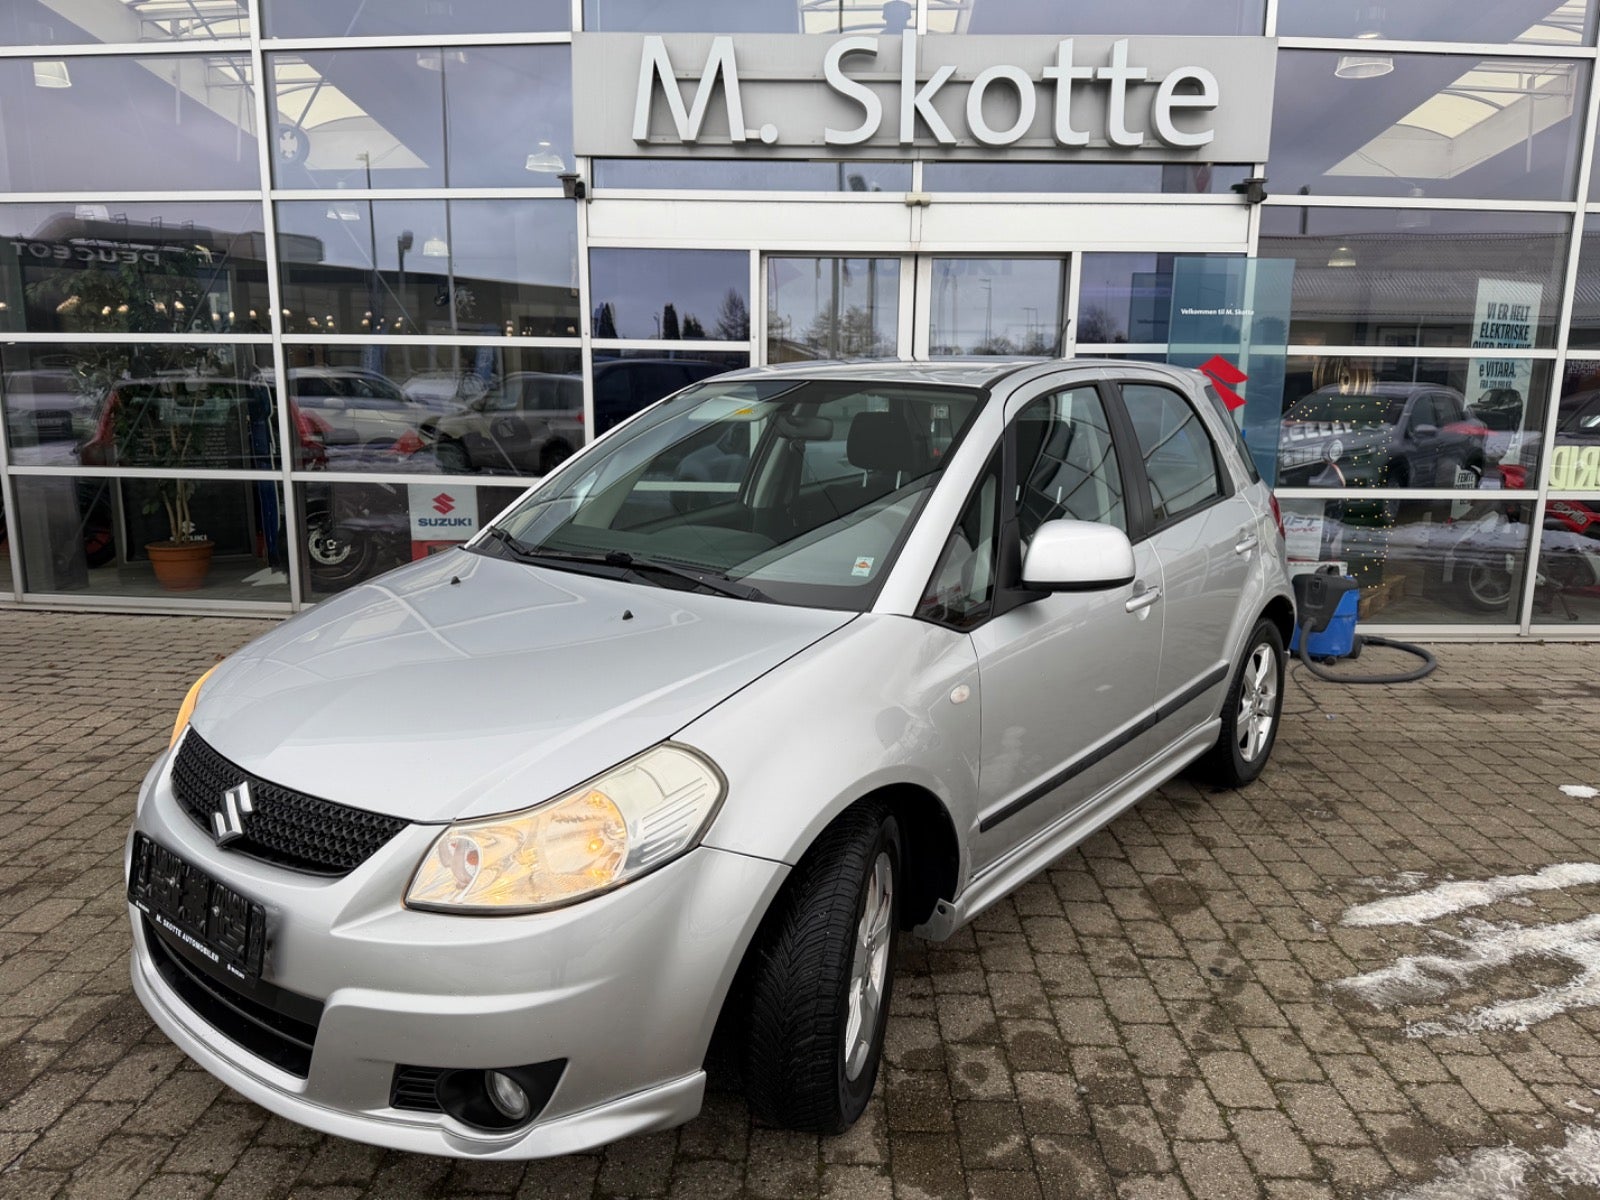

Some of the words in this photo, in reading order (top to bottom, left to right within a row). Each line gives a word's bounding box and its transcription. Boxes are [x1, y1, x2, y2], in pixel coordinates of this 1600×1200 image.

[632, 35, 779, 145] M.
[823, 29, 1220, 149] Skotte
[1181, 308, 1217, 316] Velkommen
[1235, 308, 1255, 317] Skotte
[1487, 302, 1497, 319] VI
[1498, 303, 1508, 320] ER
[1510, 305, 1531, 322] HELT
[1480, 322, 1530, 340] ELEKTRISKE
[418, 517, 472, 527] SUZUKI
[163, 918, 182, 937] SKOTTE
[182, 932, 220, 963] AUTOMOBILER
